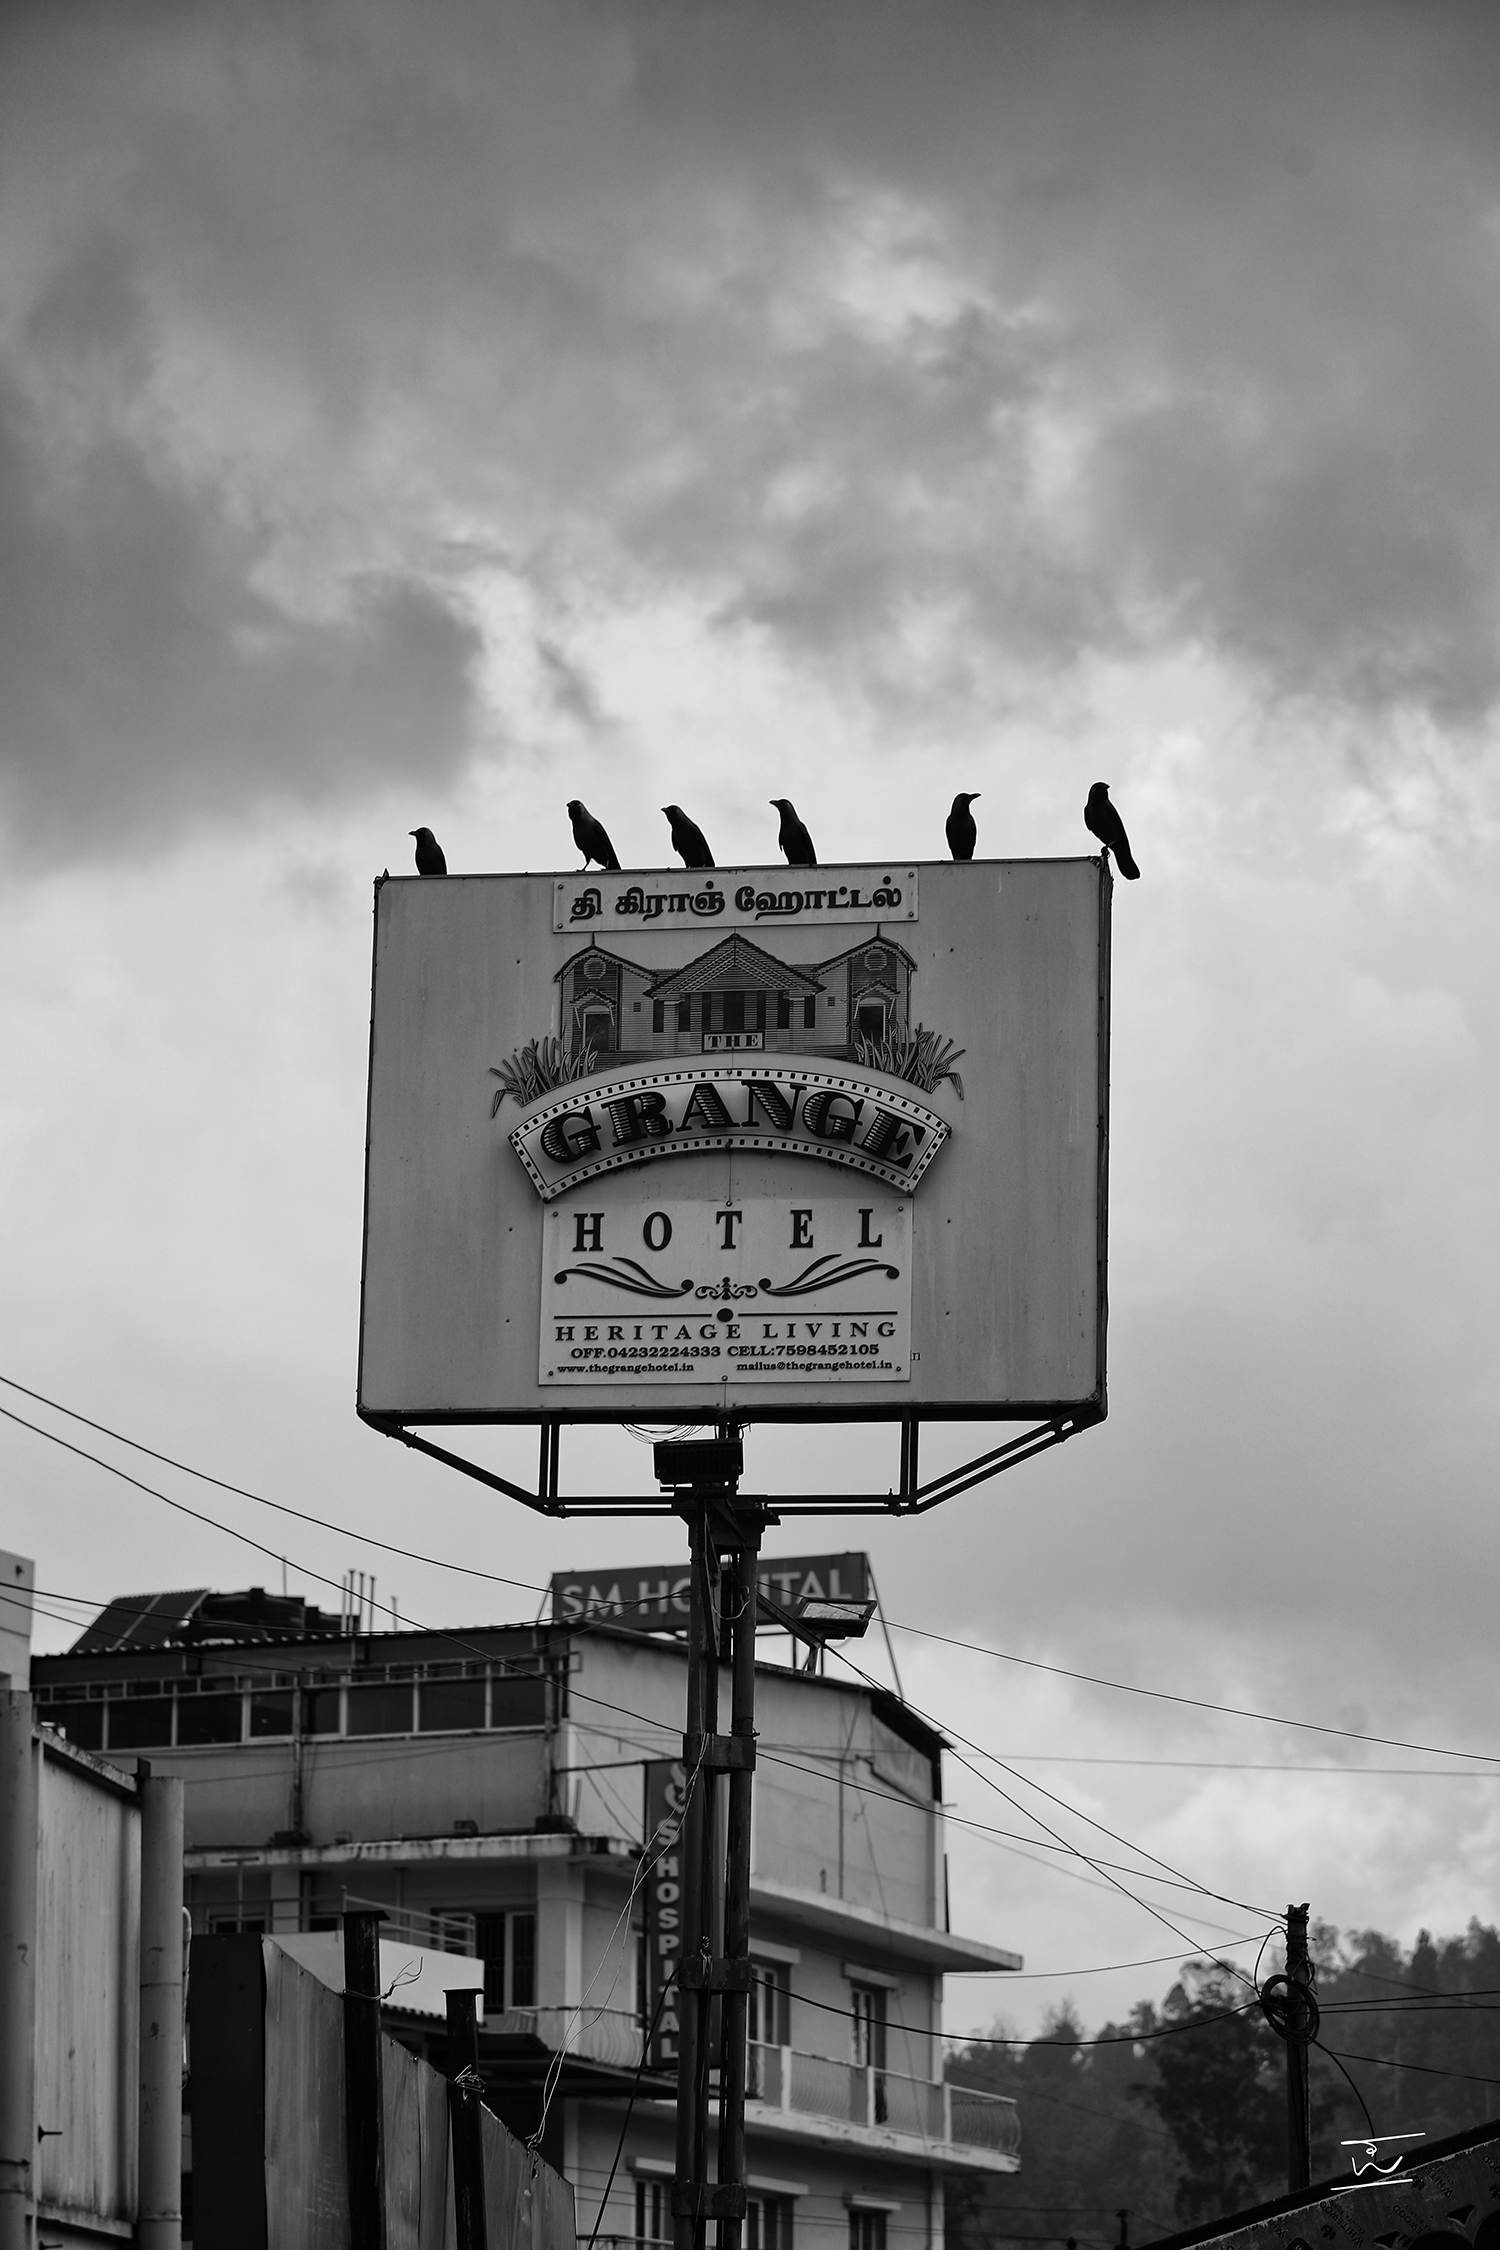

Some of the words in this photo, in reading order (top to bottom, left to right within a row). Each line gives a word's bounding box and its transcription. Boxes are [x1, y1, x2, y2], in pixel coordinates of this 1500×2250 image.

[569, 887, 603, 922] தி
[734, 876, 902, 921] ஹோட்டல்
[707, 1034, 759, 1048] THE
[540, 1081, 926, 1170] GRANGE
[572, 1208, 883, 1252] HOTEL
[555, 1323, 742, 1342] HERITAGE
[763, 1321, 897, 1339] LIVING
[571, 1346, 721, 1359] OFF.04232224333
[727, 1342, 880, 1357] CELL:7598452105
[557, 1362, 695, 1374] www.thegrangehotel.in
[736, 1359, 893, 1372] mailus@thegrangehotel.in
[561, 1581, 624, 1621] SM
[638, 1568, 852, 1615] HOITAL
[655, 1856, 680, 2059] HOSPITAL
